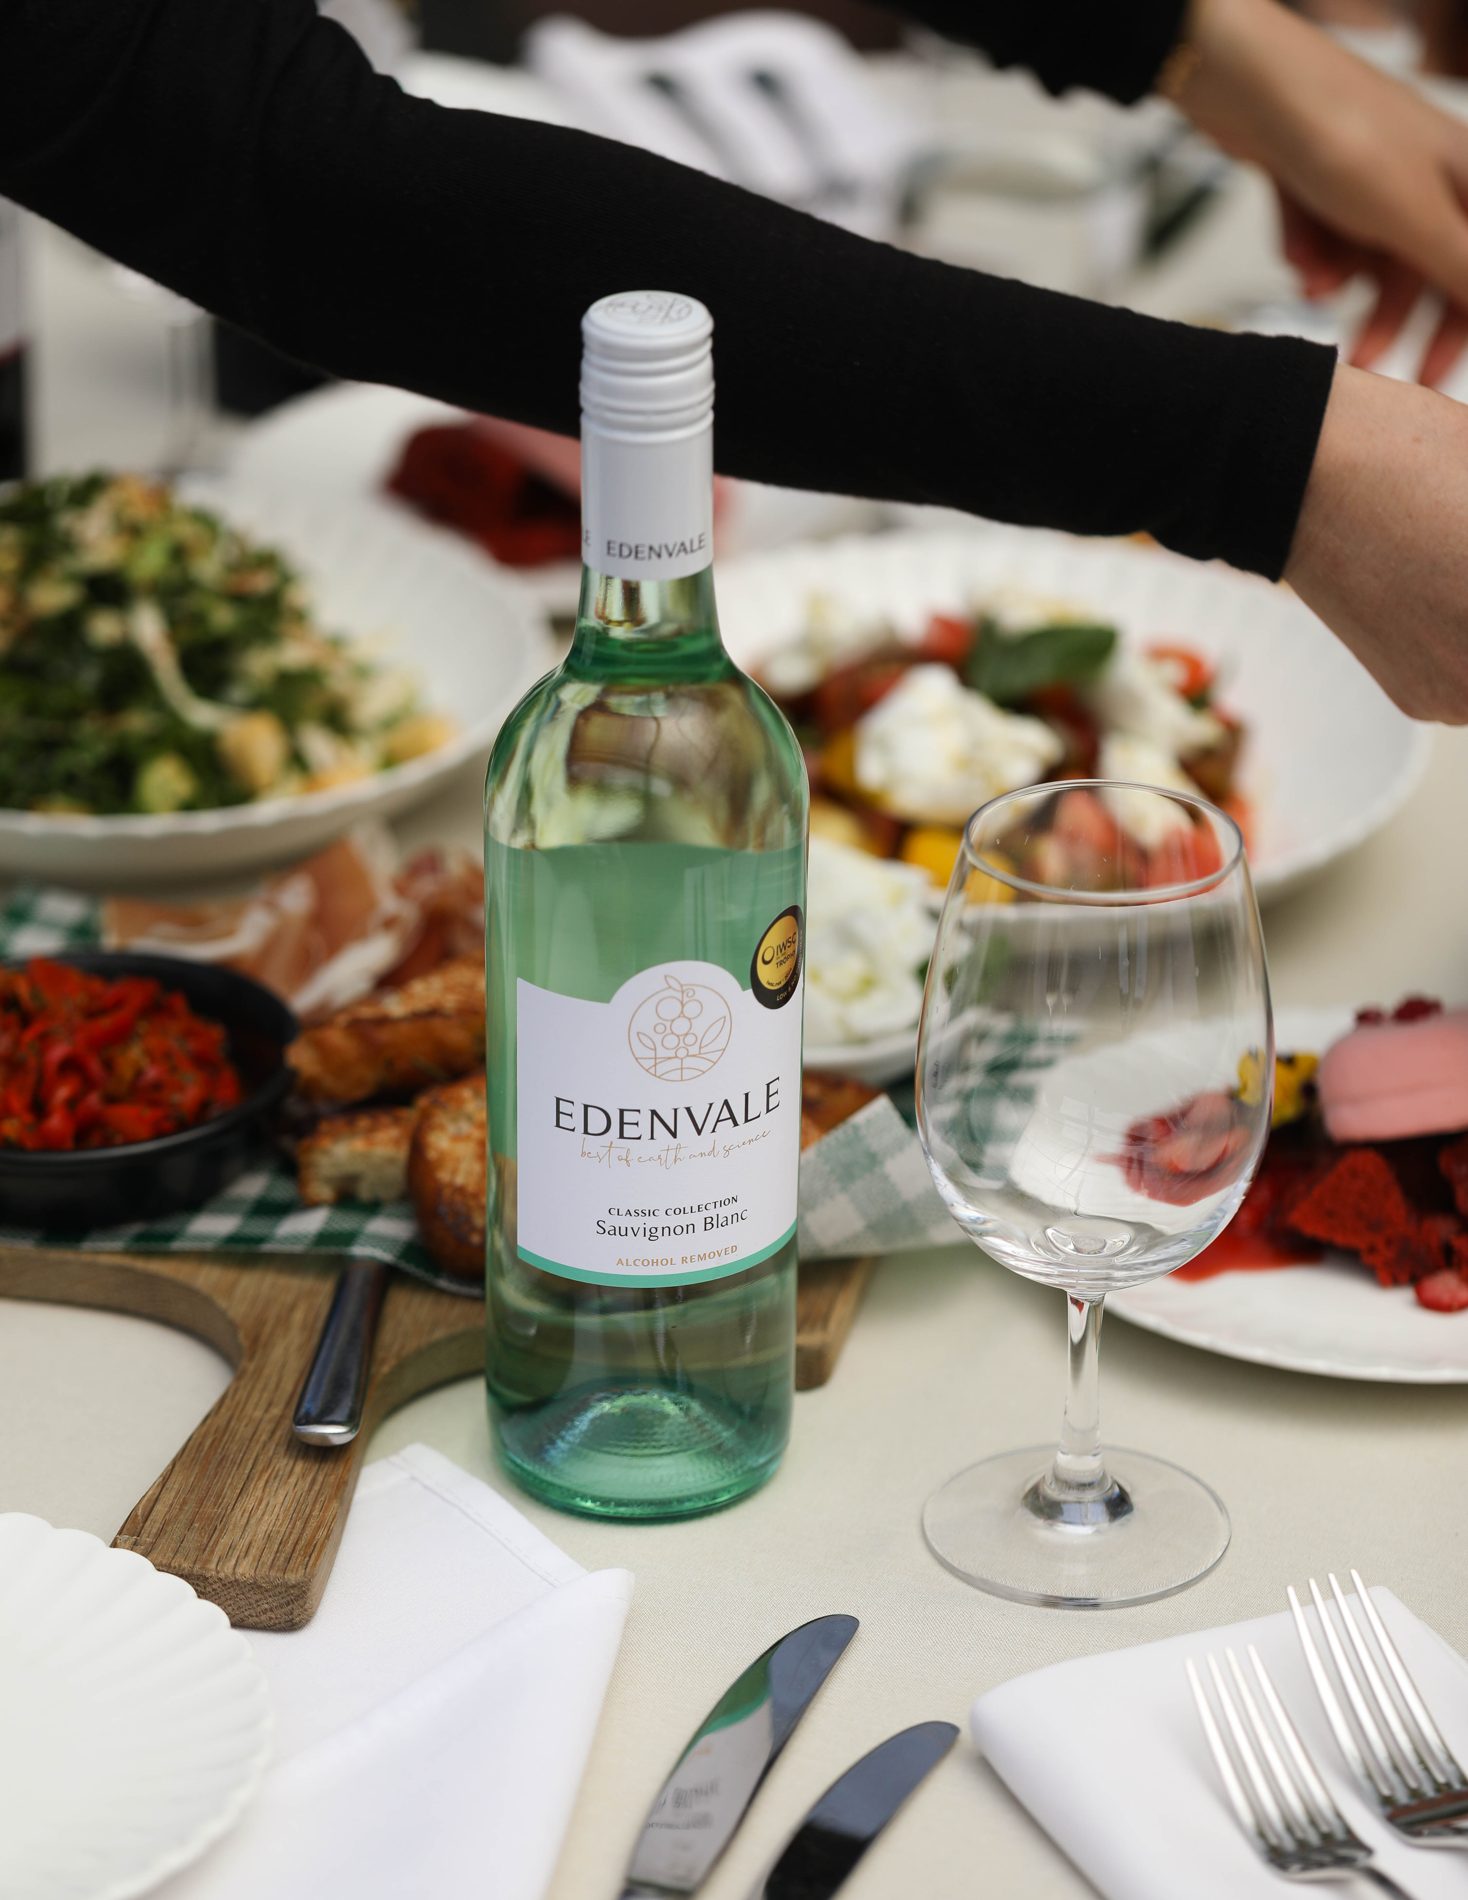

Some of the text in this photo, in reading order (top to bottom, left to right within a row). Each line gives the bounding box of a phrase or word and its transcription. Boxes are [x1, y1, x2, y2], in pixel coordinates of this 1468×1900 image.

[606, 532, 706, 561] EDENVALE
[776, 932, 797, 956] IWSC
[554, 1076, 781, 1140] EDENVALE
[580, 1129, 771, 1170] best of earth and science
[608, 1195, 738, 1217] CLASSIC COLLECTION
[596, 1209, 748, 1241] Sauvignon Blanc
[616, 1246, 738, 1267] ALCOHOL REMOVED
